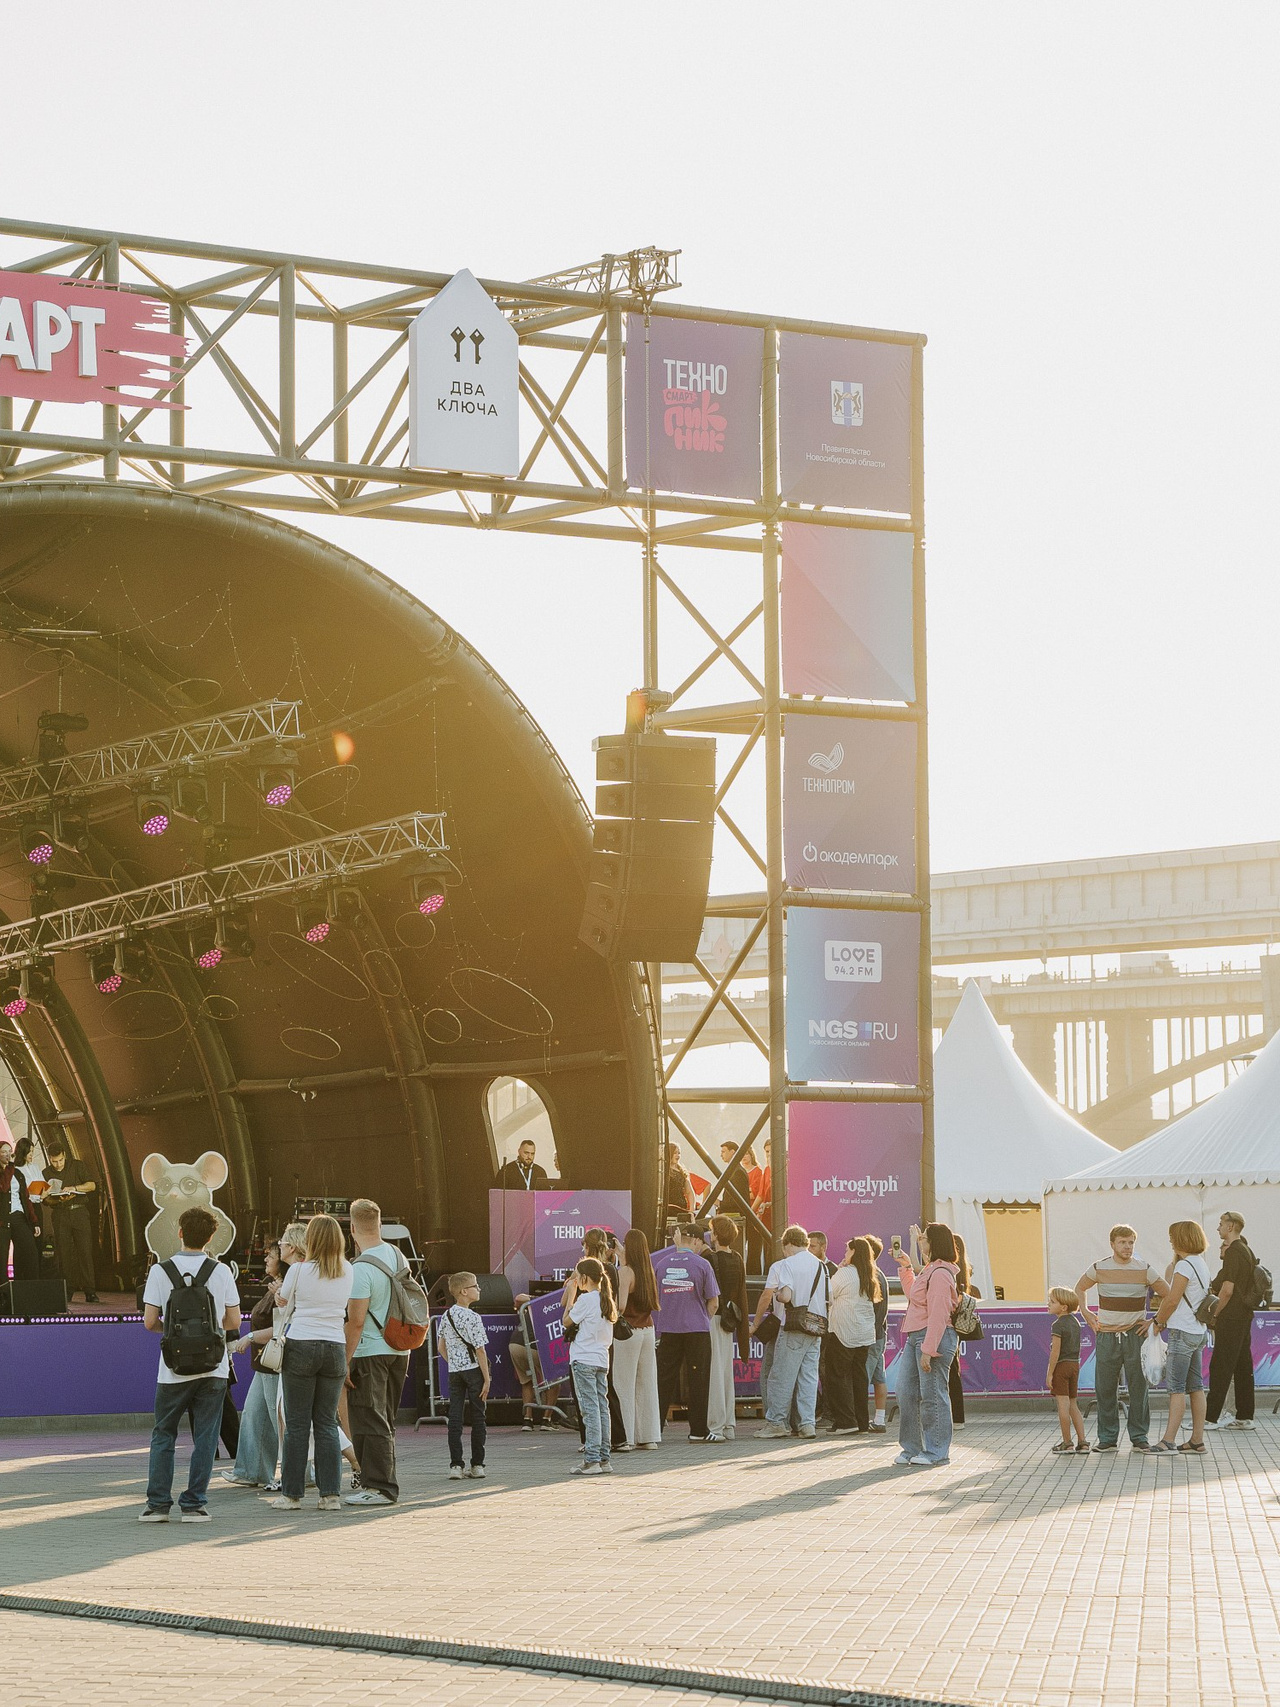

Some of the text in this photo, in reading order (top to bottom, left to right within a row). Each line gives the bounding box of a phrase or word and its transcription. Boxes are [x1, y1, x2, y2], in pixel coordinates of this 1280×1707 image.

[663, 358, 728, 395] ТЕХНО
[450, 380, 486, 397] ДВА
[665, 391, 694, 402] СМАРТ
[437, 398, 499, 418] КЛЮЧА
[821, 443, 871, 457] Правительство
[805, 452, 886, 469] Новосибирской области
[802, 777, 855, 794] ТЕХНОПРОМ
[819, 850, 899, 869] академпарк
[834, 965, 873, 976] 94.2 FM
[808, 1019, 898, 1041] NGS RU
[808, 1039, 847, 1047] НОВОСИБИРСК
[812, 1174, 899, 1197] petroglyph
[553, 1225, 585, 1239] ТЕХНО
[487, 1324, 508, 1333] науки
[993, 1323, 1024, 1331] искусства
[991, 1334, 1023, 1351] ТЕХНО
